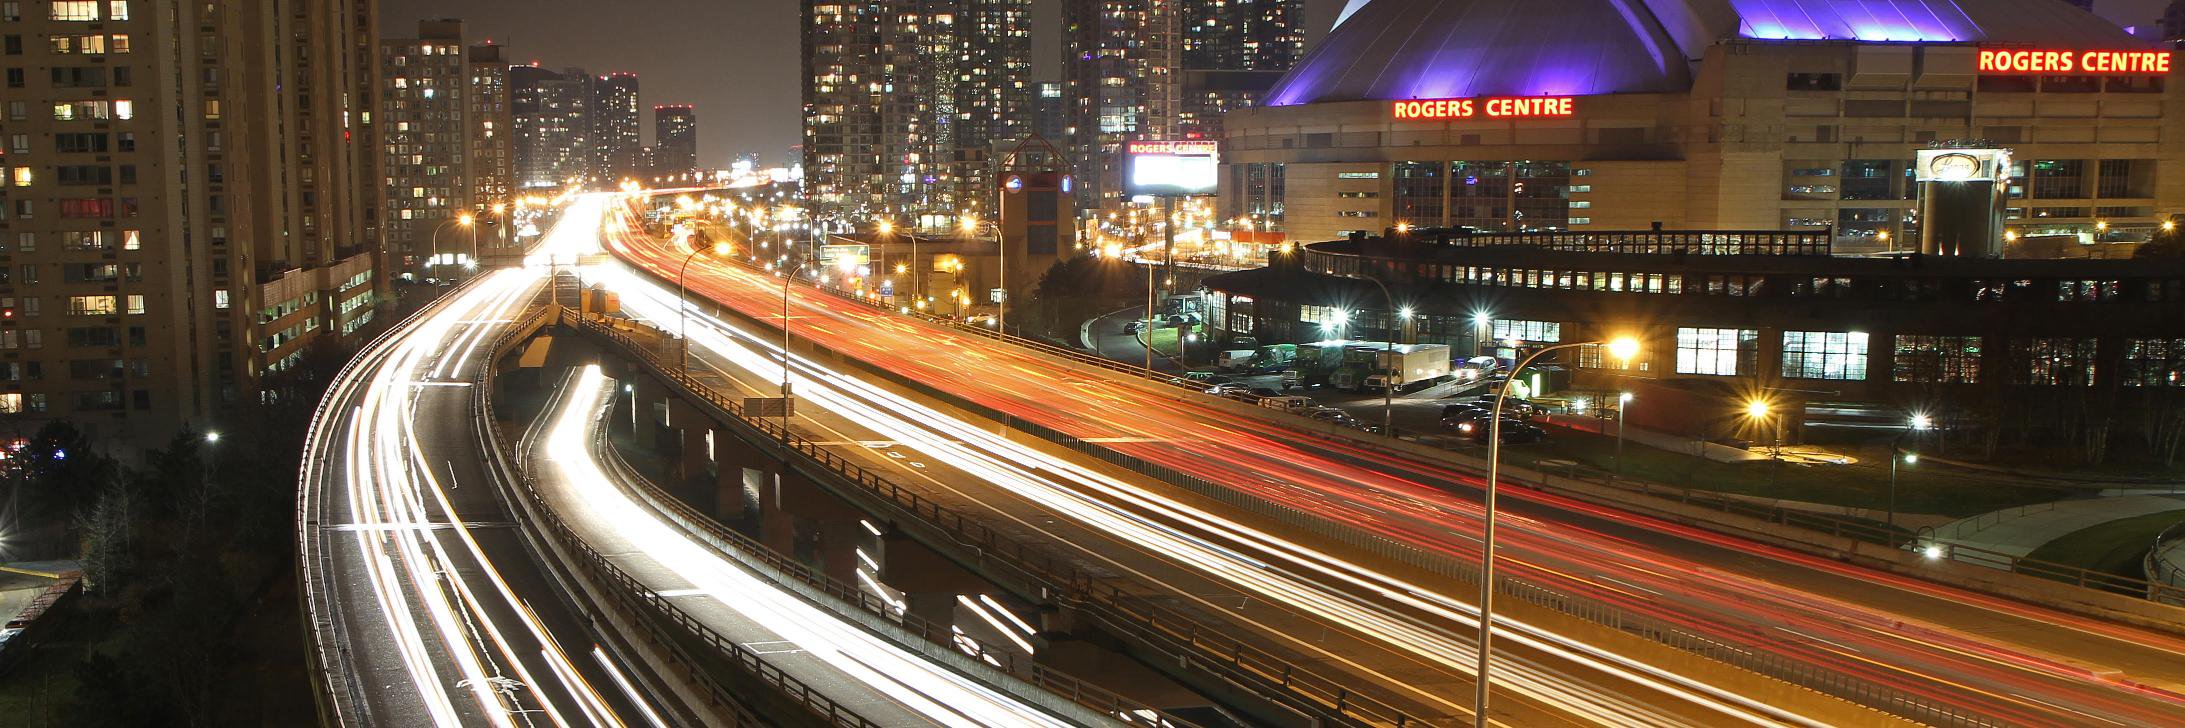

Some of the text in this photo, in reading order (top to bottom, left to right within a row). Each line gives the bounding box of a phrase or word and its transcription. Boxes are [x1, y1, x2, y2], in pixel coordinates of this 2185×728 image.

[1979, 51, 2170, 72] ROGERS CENTRE
[1395, 98, 1572, 118] ROGERS CENTRE
[1130, 143, 1216, 154] ROGERS CENTRE
